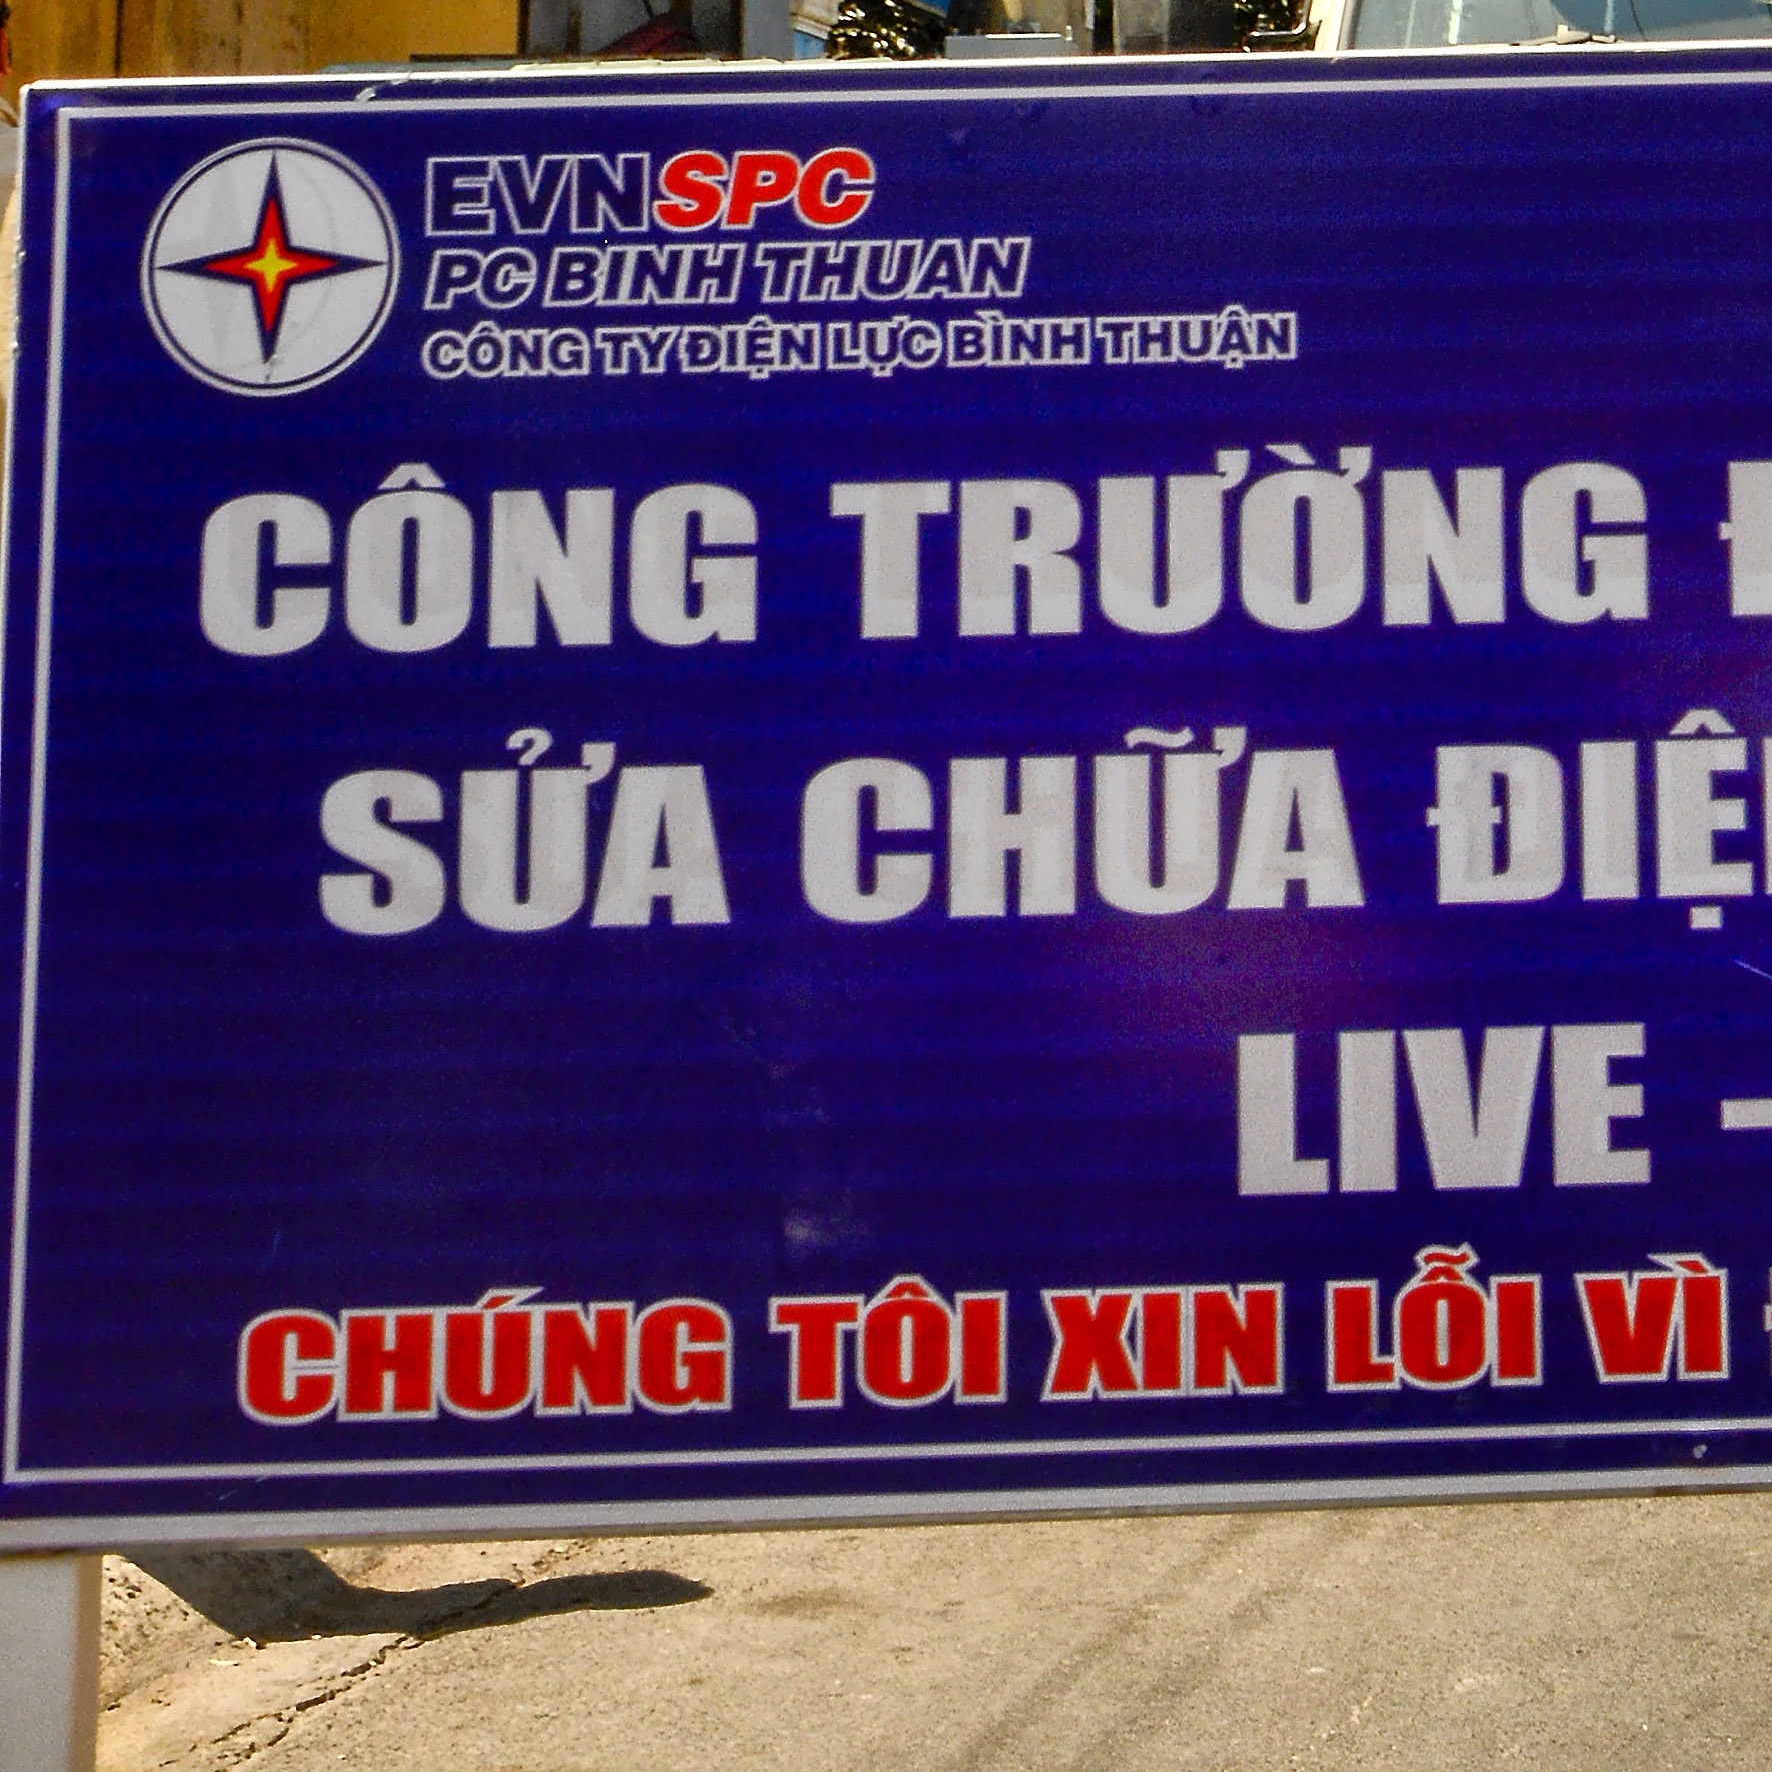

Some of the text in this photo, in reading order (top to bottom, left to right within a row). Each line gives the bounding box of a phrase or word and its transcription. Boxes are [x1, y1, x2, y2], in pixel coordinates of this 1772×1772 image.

[421, 304, 1297, 379] CÔNG TY ĐIỆN LỰC BÌNH THUẬN
[424, 236, 1032, 311] PC BINH THUAN
[202, 464, 757, 656] CÔNG
[832, 444, 1648, 639] TRƯỜNG
[321, 728, 730, 935] SỬA
[803, 727, 1364, 923] CHỮA
[1238, 1024, 1650, 1195] LIVE
[239, 1288, 734, 1423] CHÚNG
[770, 1274, 1007, 1410] TÔI
[1042, 1283, 1284, 1401] XIN
[1326, 1243, 1542, 1392] LỖI
[1574, 1253, 1729, 1383] VÌ
